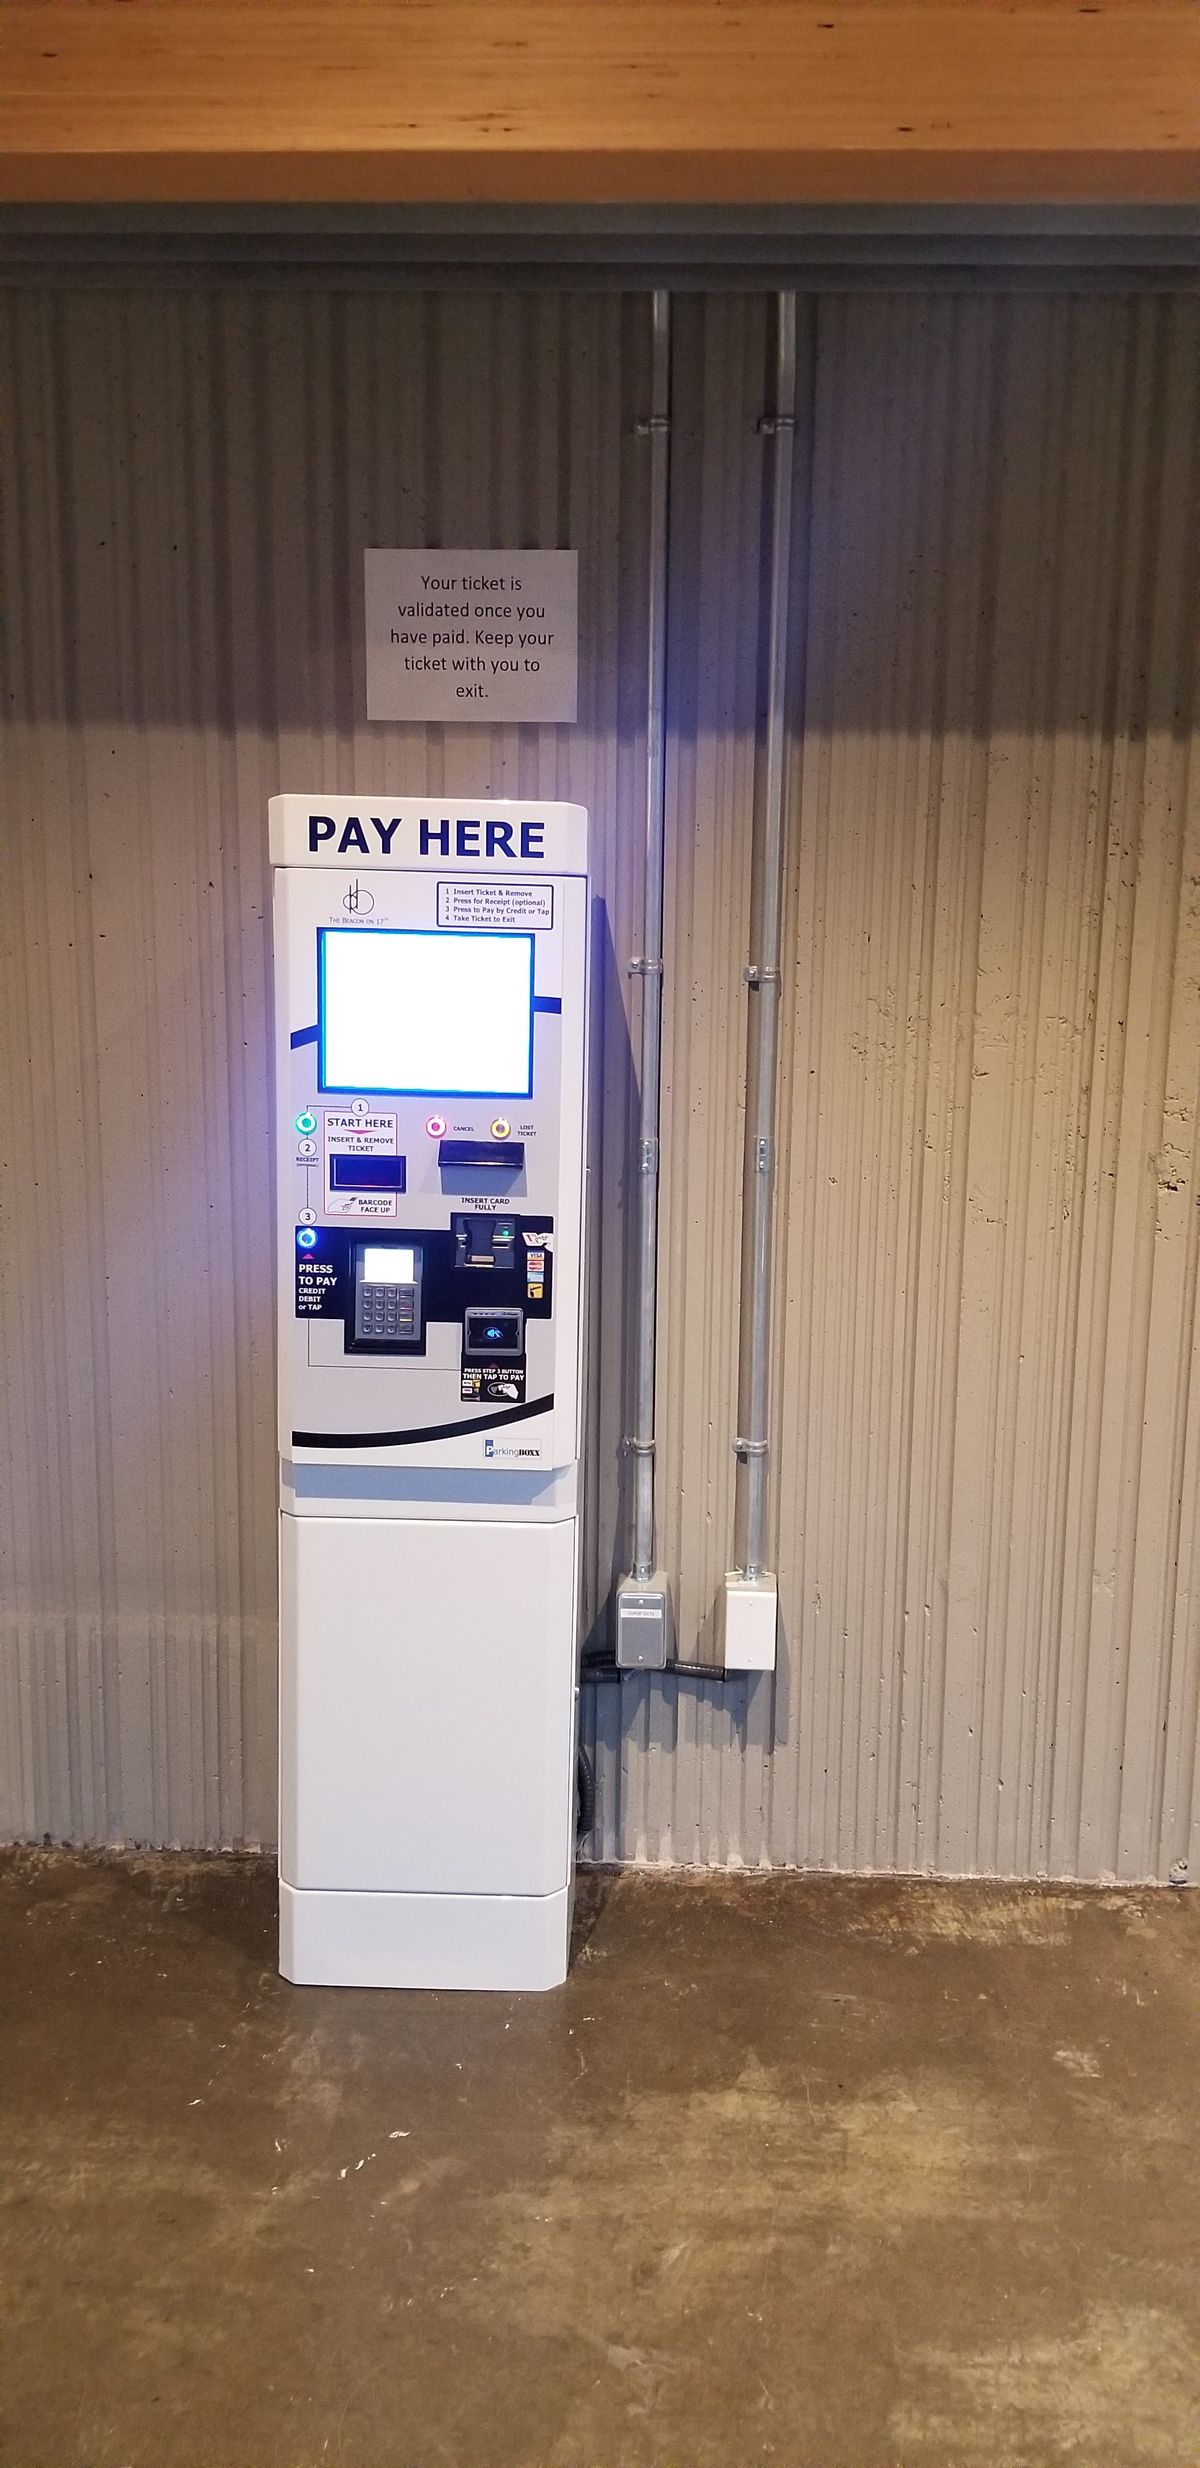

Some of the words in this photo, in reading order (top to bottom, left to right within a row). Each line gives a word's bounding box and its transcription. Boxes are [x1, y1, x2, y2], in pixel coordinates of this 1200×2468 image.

[421, 575, 457, 591] Your
[461, 576, 505, 591] ticket
[510, 576, 522, 591] is
[398, 602, 469, 618] validated
[474, 607, 512, 618] once
[516, 607, 545, 621] you
[390, 628, 427, 645] have
[432, 630, 470, 647] paid.
[475, 630, 514, 648] Keep
[518, 634, 554, 648] your
[404, 656, 447, 671] ticket
[452, 656, 486, 672] with
[490, 660, 519, 675] you
[524, 658, 541, 672] to
[455, 683, 489, 698] exit.
[308, 815, 402, 855] PAY
[419, 818, 545, 859] HERE
[453, 888, 474, 896] Insert
[453, 897, 472, 905] Press
[485, 898, 510, 907] Receipt
[512, 899, 546, 907] (optional)
[482, 907, 495, 915] Pay
[496, 907, 505, 915] by
[471, 915, 492, 923] Ticket
[357, 1104, 364, 1112] 1
[327, 1118, 362, 1127] START
[365, 1119, 394, 1128] HERE
[305, 1144, 311, 1152] 2
[304, 1212, 311, 1221] 3
[299, 1264, 333, 1273] PRESS
[298, 1276, 313, 1285] TO
[316, 1276, 337, 1286] PAY
